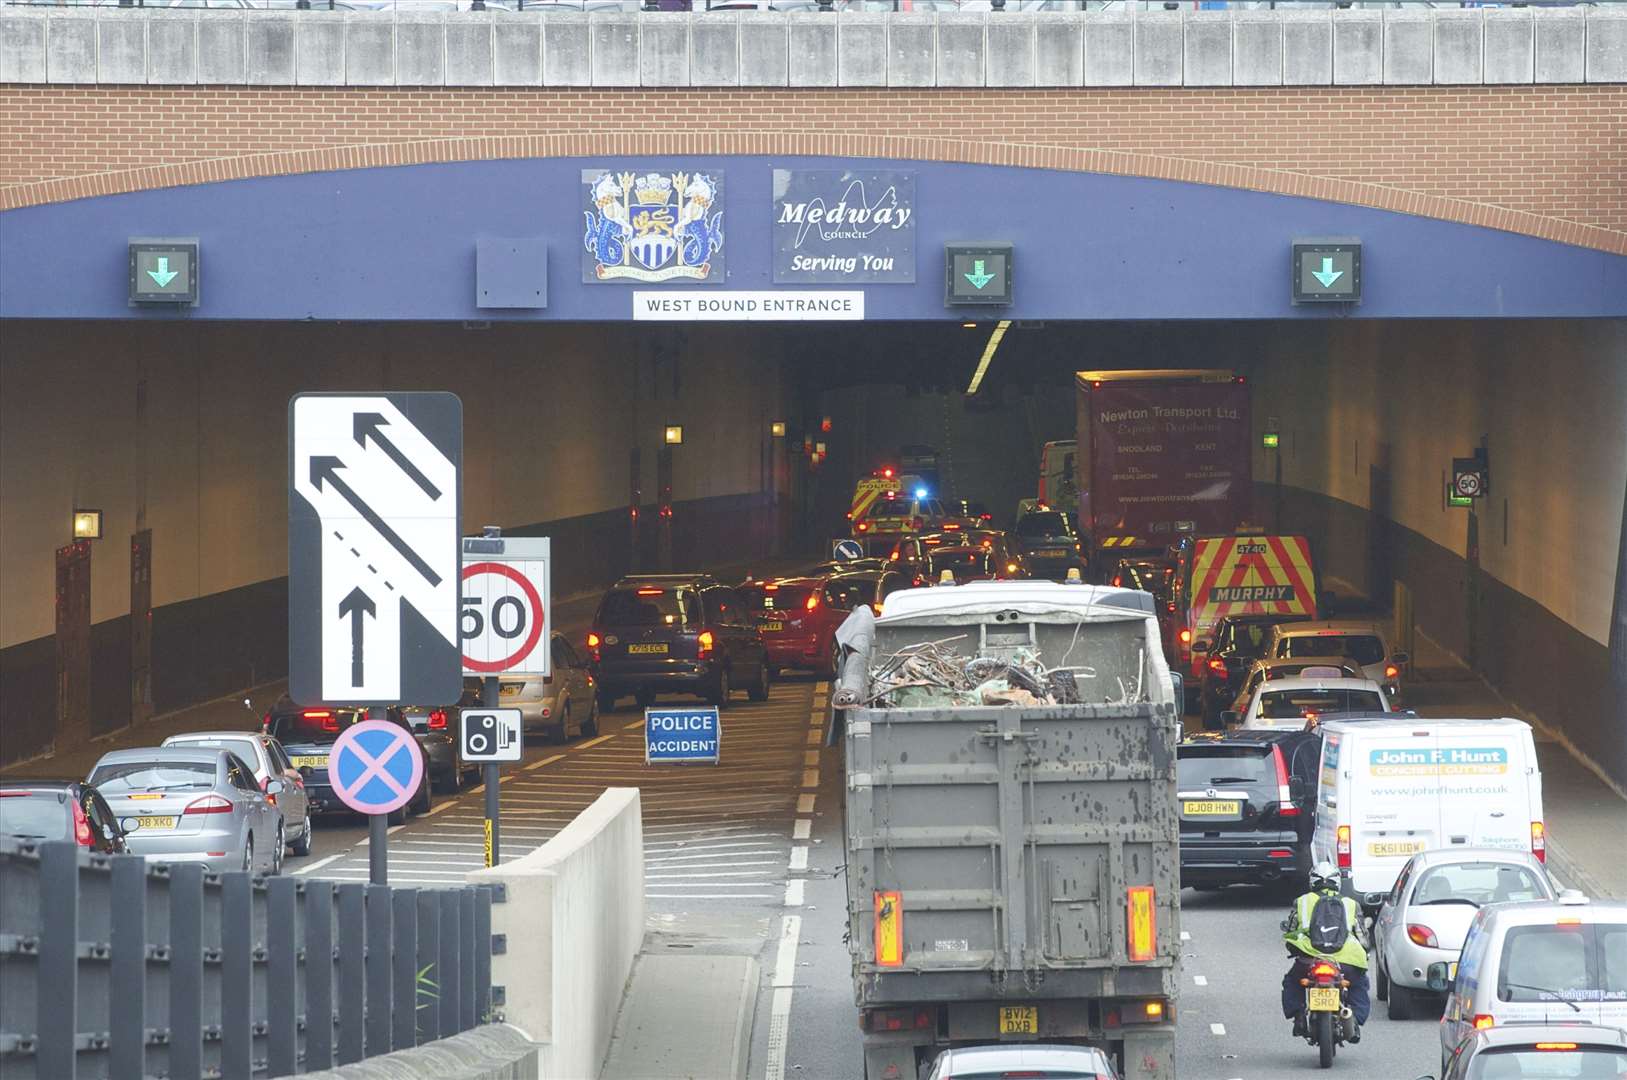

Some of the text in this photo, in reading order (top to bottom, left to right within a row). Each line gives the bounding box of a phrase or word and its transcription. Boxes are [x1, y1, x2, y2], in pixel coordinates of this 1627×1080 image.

[778, 202, 911, 229] Medway
[824, 231, 868, 240] COUNCIL
[791, 254, 894, 274] Serving You
[647, 298, 852, 312] WEST BOUND ENTRANCE
[1100, 408, 1148, 423] Newton
[1153, 406, 1211, 418] Transport
[1460, 479, 1477, 489] 50
[1238, 544, 1266, 554] 4740
[1215, 587, 1287, 601] MURPHY
[462, 595, 526, 640] 50
[651, 716, 712, 731] POLICE
[648, 740, 716, 753] ACCIDENT
[1376, 751, 1426, 764] John
[1451, 749, 1501, 763] Hunt
[1188, 803, 1234, 813] GJ08 HWN
[1006, 1008, 1032, 1019] BV12
